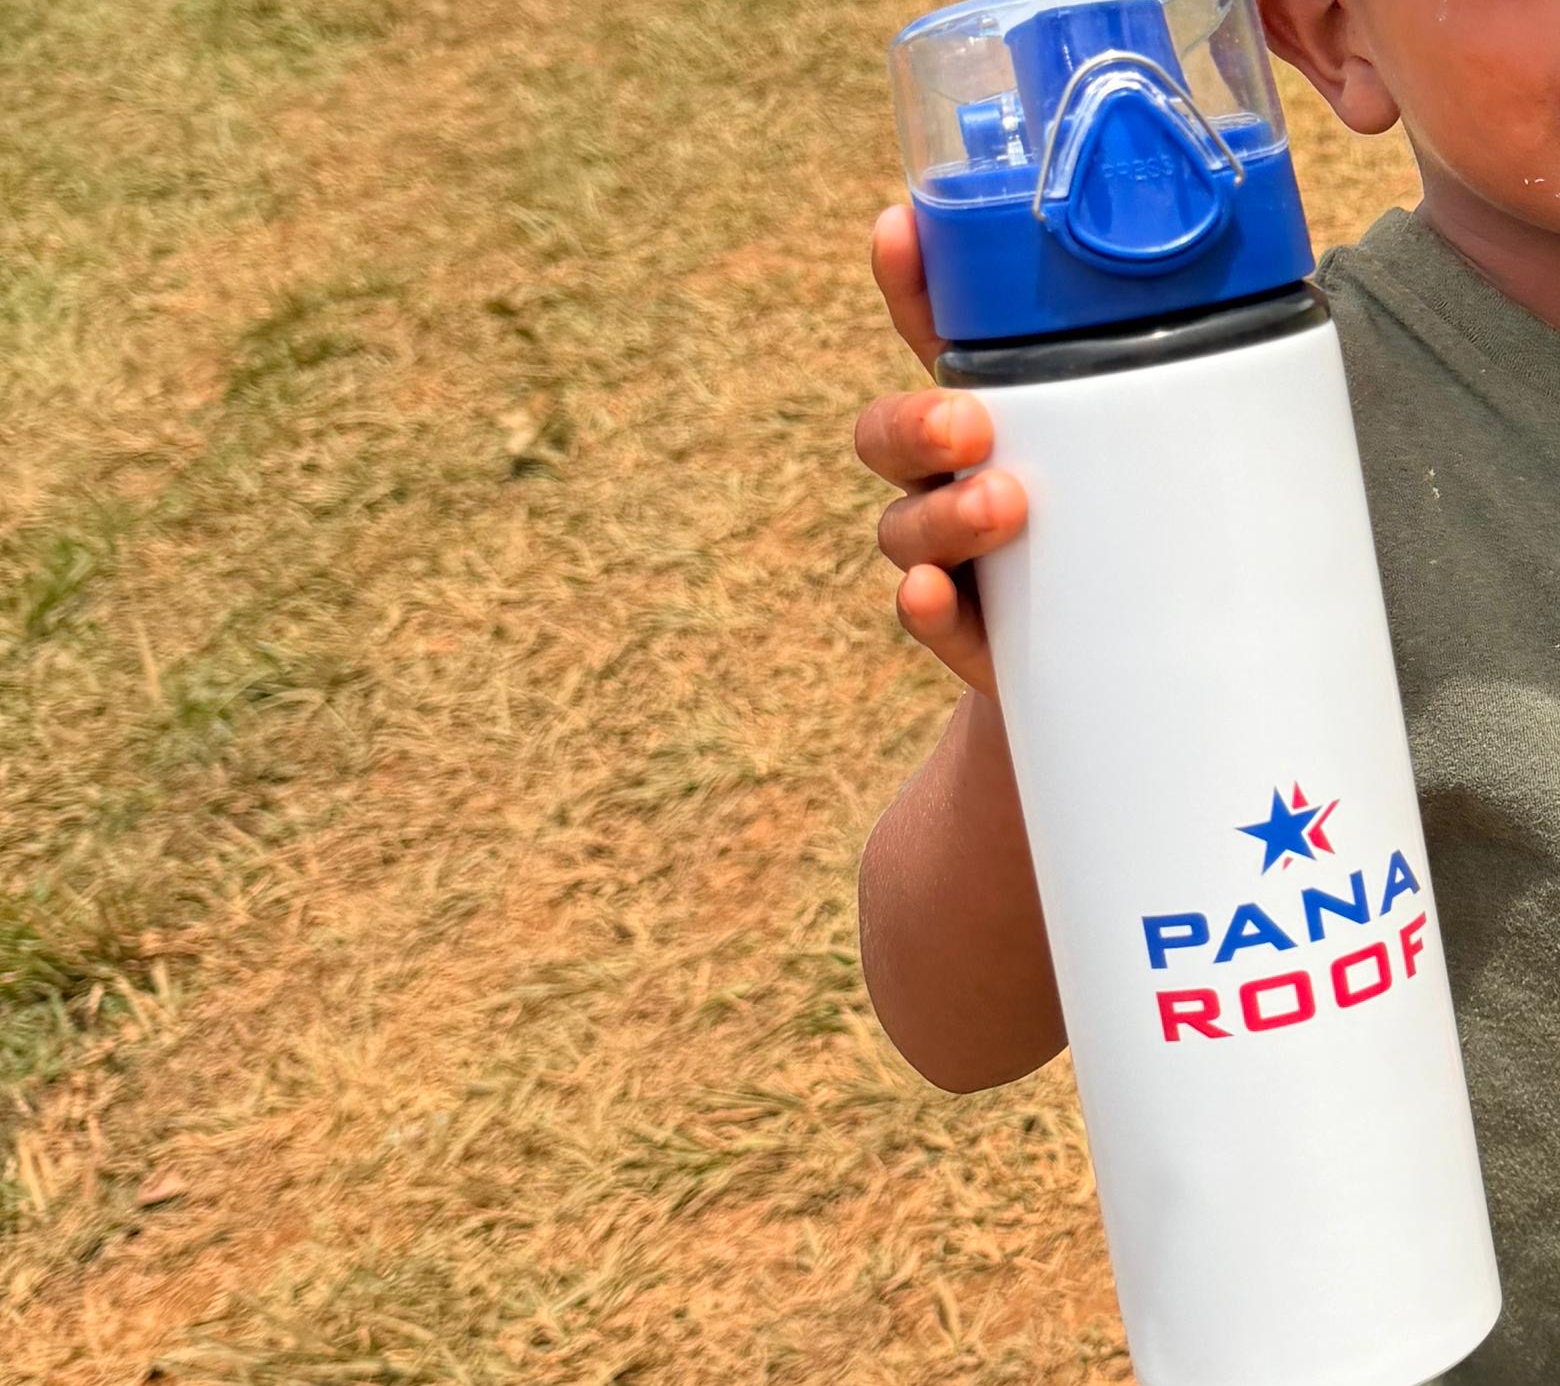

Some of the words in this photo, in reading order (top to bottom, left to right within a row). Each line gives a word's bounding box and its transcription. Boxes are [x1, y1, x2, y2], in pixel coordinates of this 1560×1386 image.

[1101, 153, 1175, 181] PRESS
[1141, 849, 1421, 969] PANA
[1156, 911, 1428, 1043] ROOF
